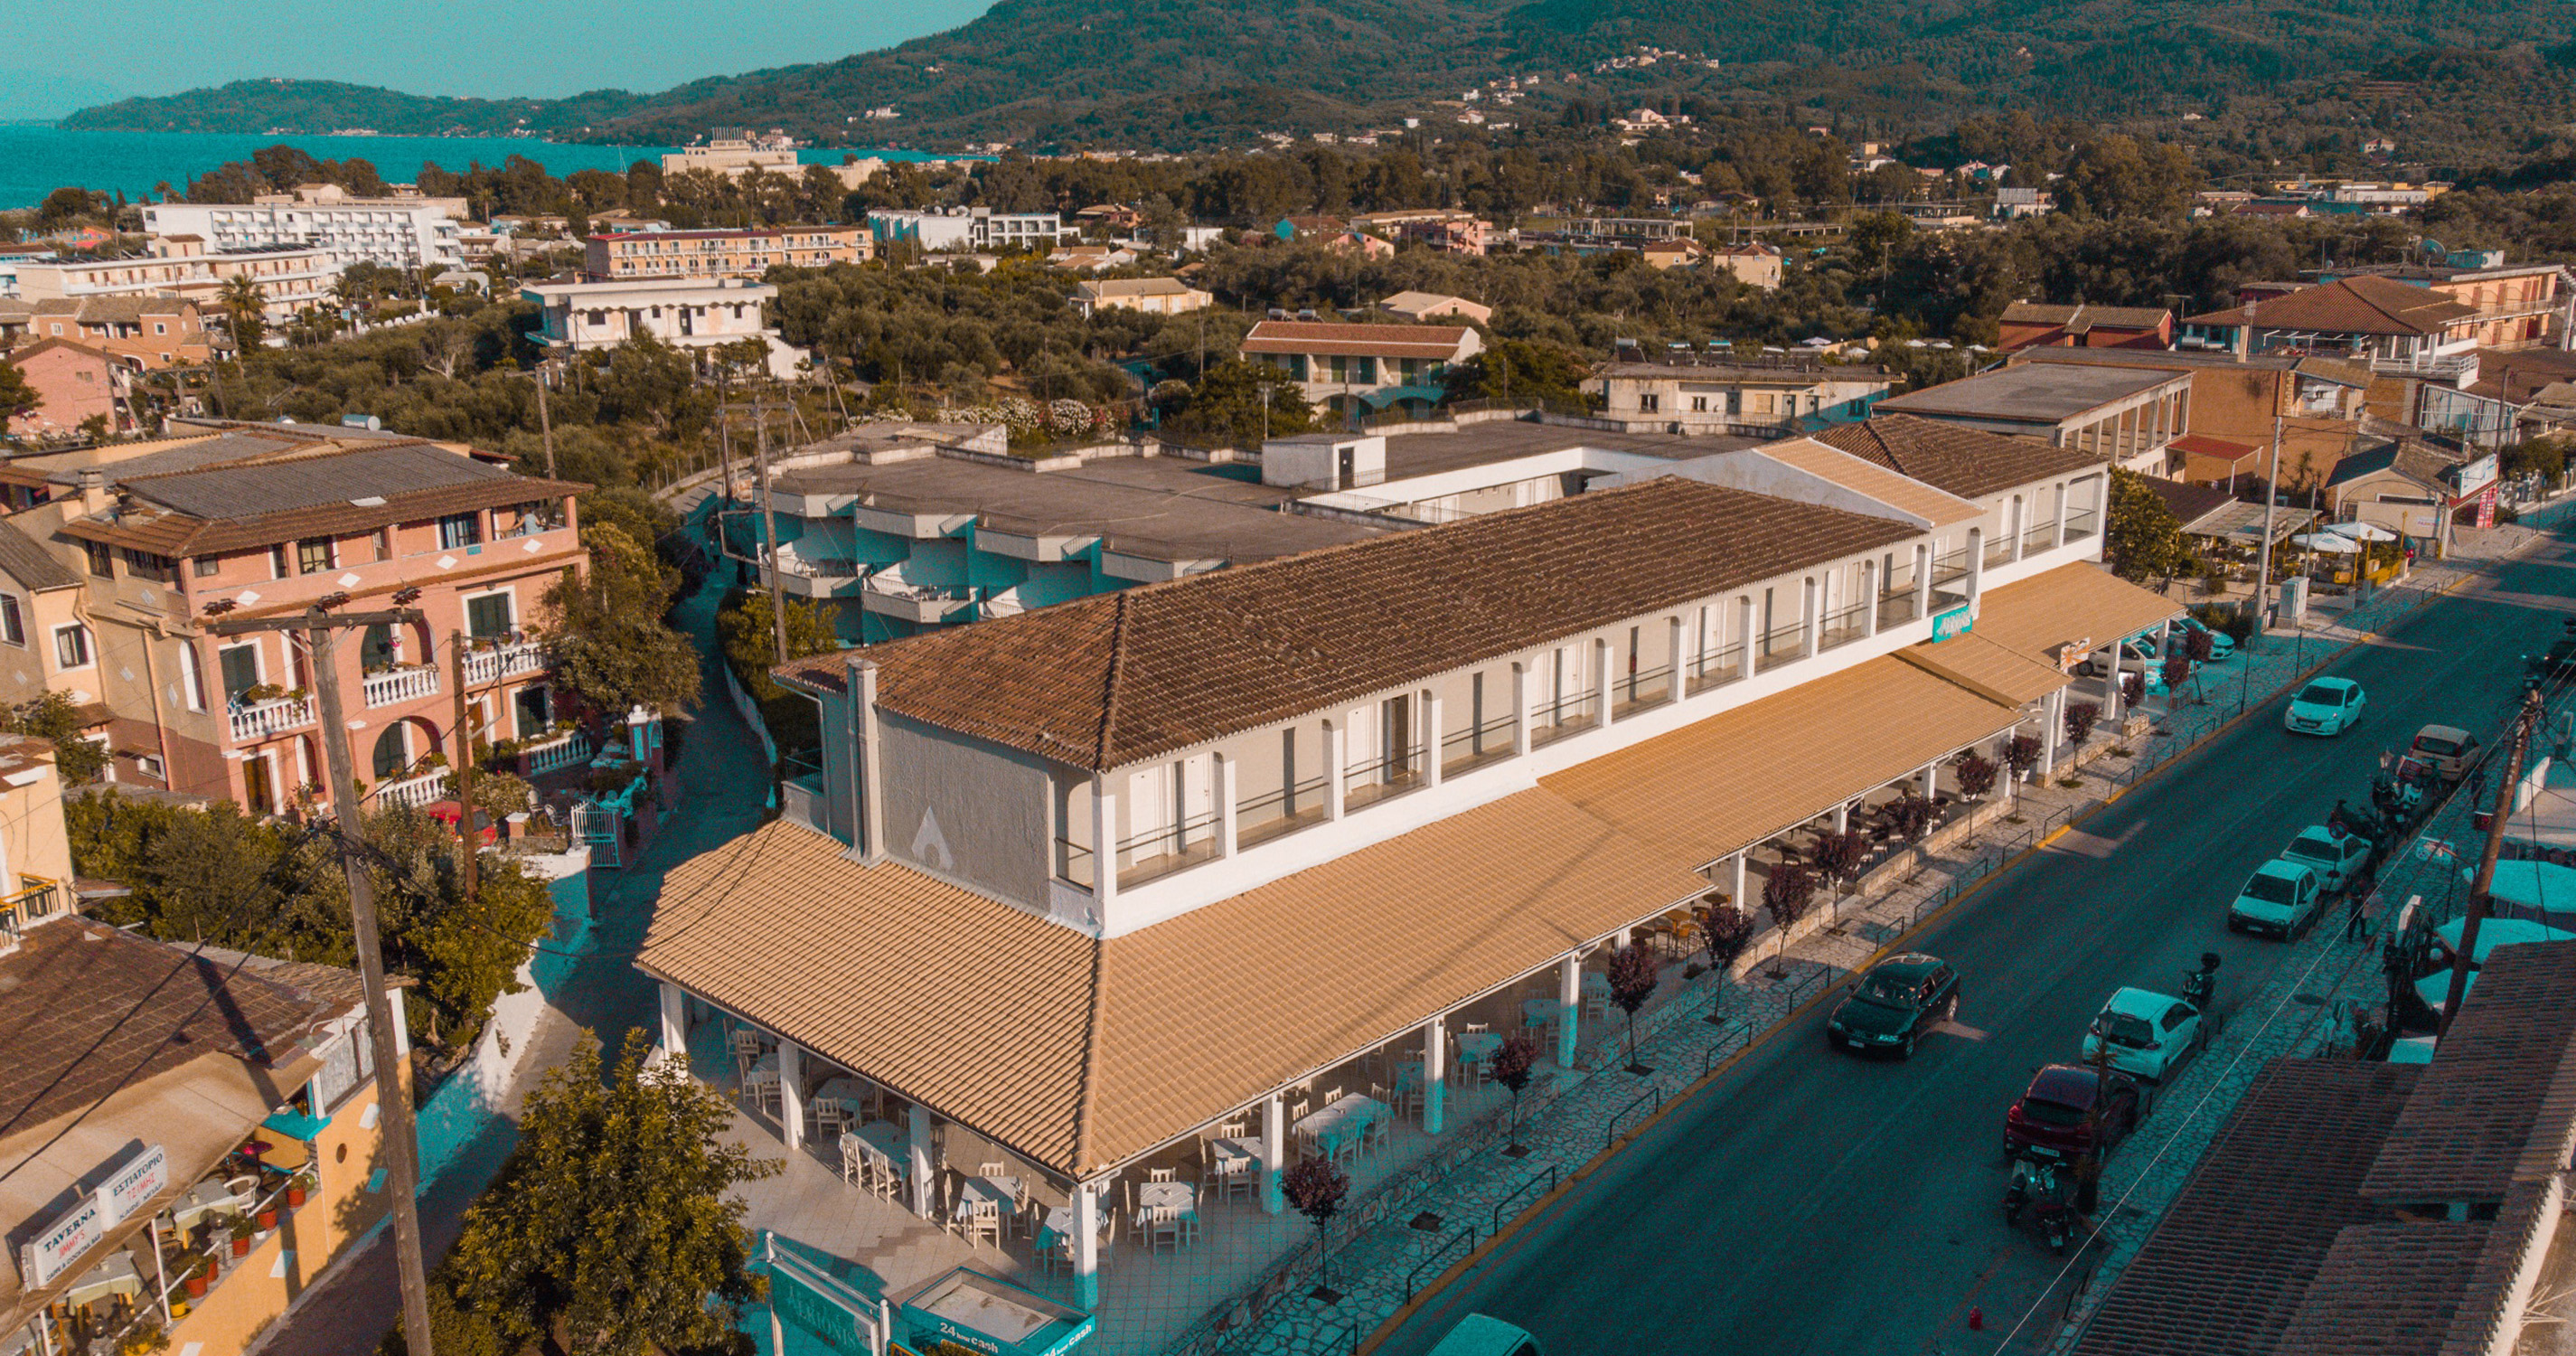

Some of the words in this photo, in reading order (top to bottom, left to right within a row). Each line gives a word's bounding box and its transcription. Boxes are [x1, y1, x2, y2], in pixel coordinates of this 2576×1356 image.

[113, 1153, 163, 1197] ΕΣΤΙΑΤΟΡΙΟ
[44, 1209, 96, 1252] TAVERNA
[940, 1322, 955, 1337] 24
[971, 1337, 999, 1354] cash
[1069, 1324, 1092, 1345] cash
